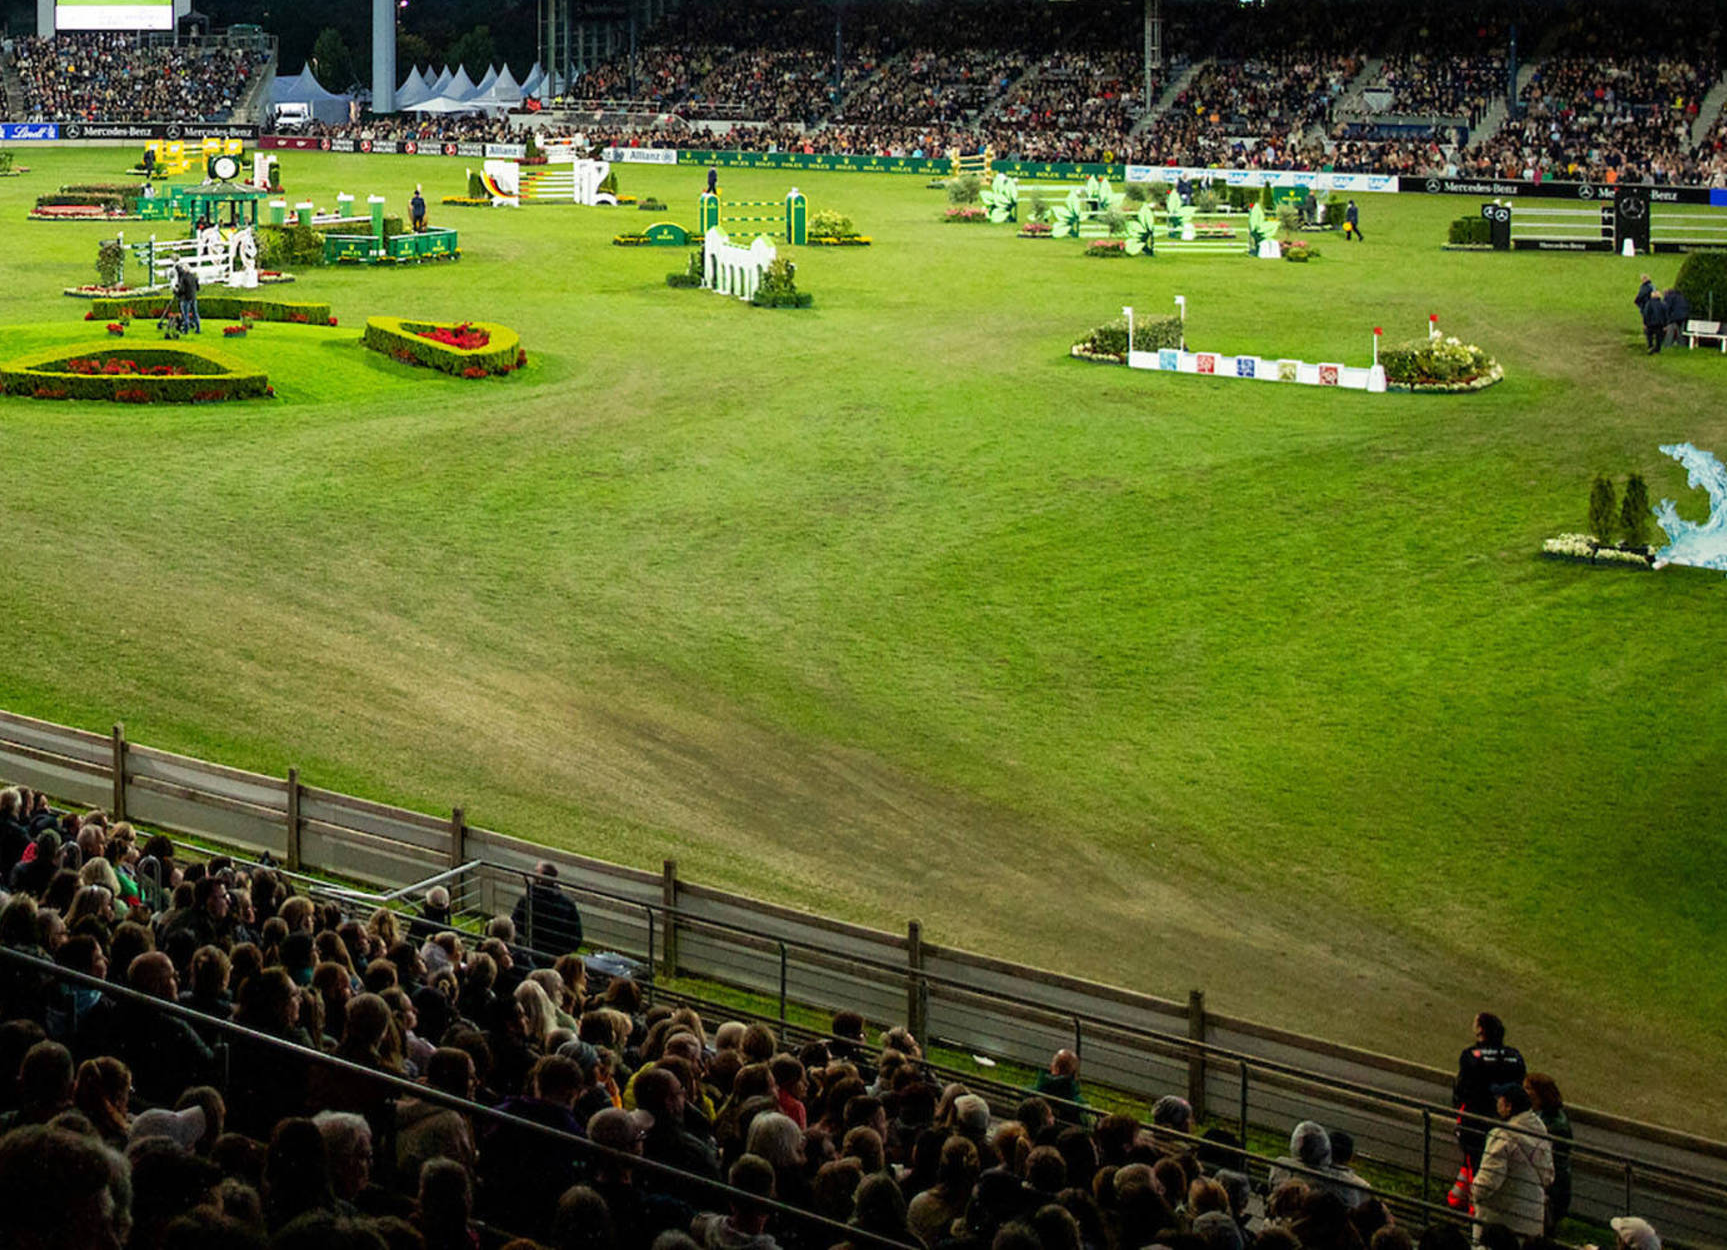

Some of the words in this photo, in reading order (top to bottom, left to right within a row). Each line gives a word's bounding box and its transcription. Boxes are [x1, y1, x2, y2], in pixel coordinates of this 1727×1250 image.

[11, 126, 48, 140] Lindt
[83, 125, 152, 136] Mercedes-Benz
[184, 125, 252, 137] Mercedes-Benz
[489, 145, 517, 155] Allianz
[630, 150, 661, 160] Allianz
[1443, 181, 1518, 195] Mercedes-Benz
